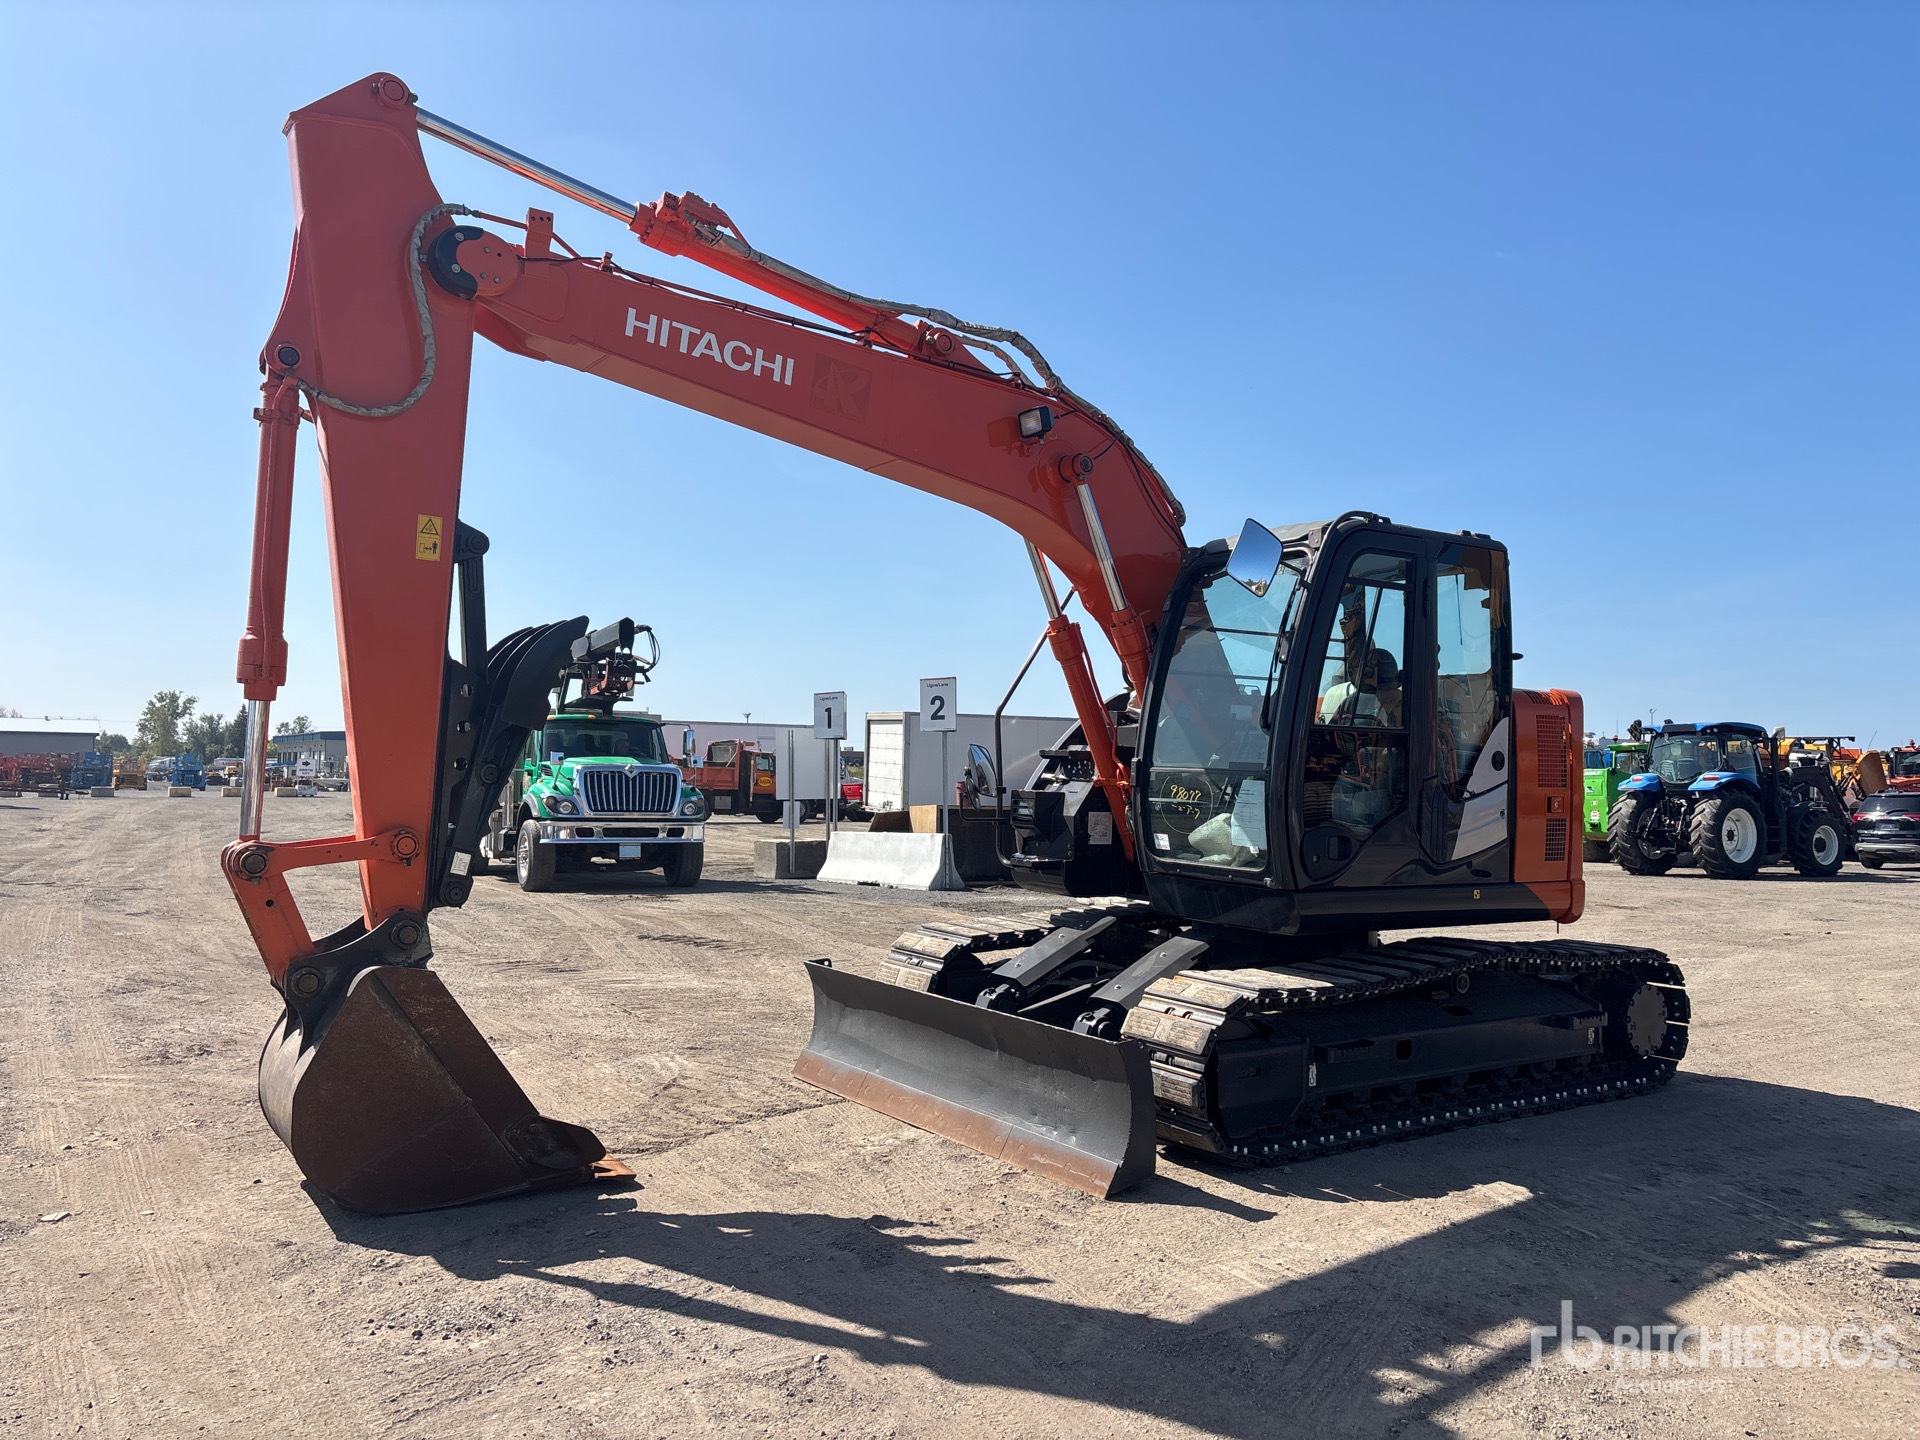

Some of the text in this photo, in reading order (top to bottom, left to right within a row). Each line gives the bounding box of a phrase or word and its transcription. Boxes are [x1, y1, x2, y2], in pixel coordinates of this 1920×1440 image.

[625, 307, 794, 386] HITACHI
[825, 707, 831, 729] 1
[930, 696, 945, 720] 2
